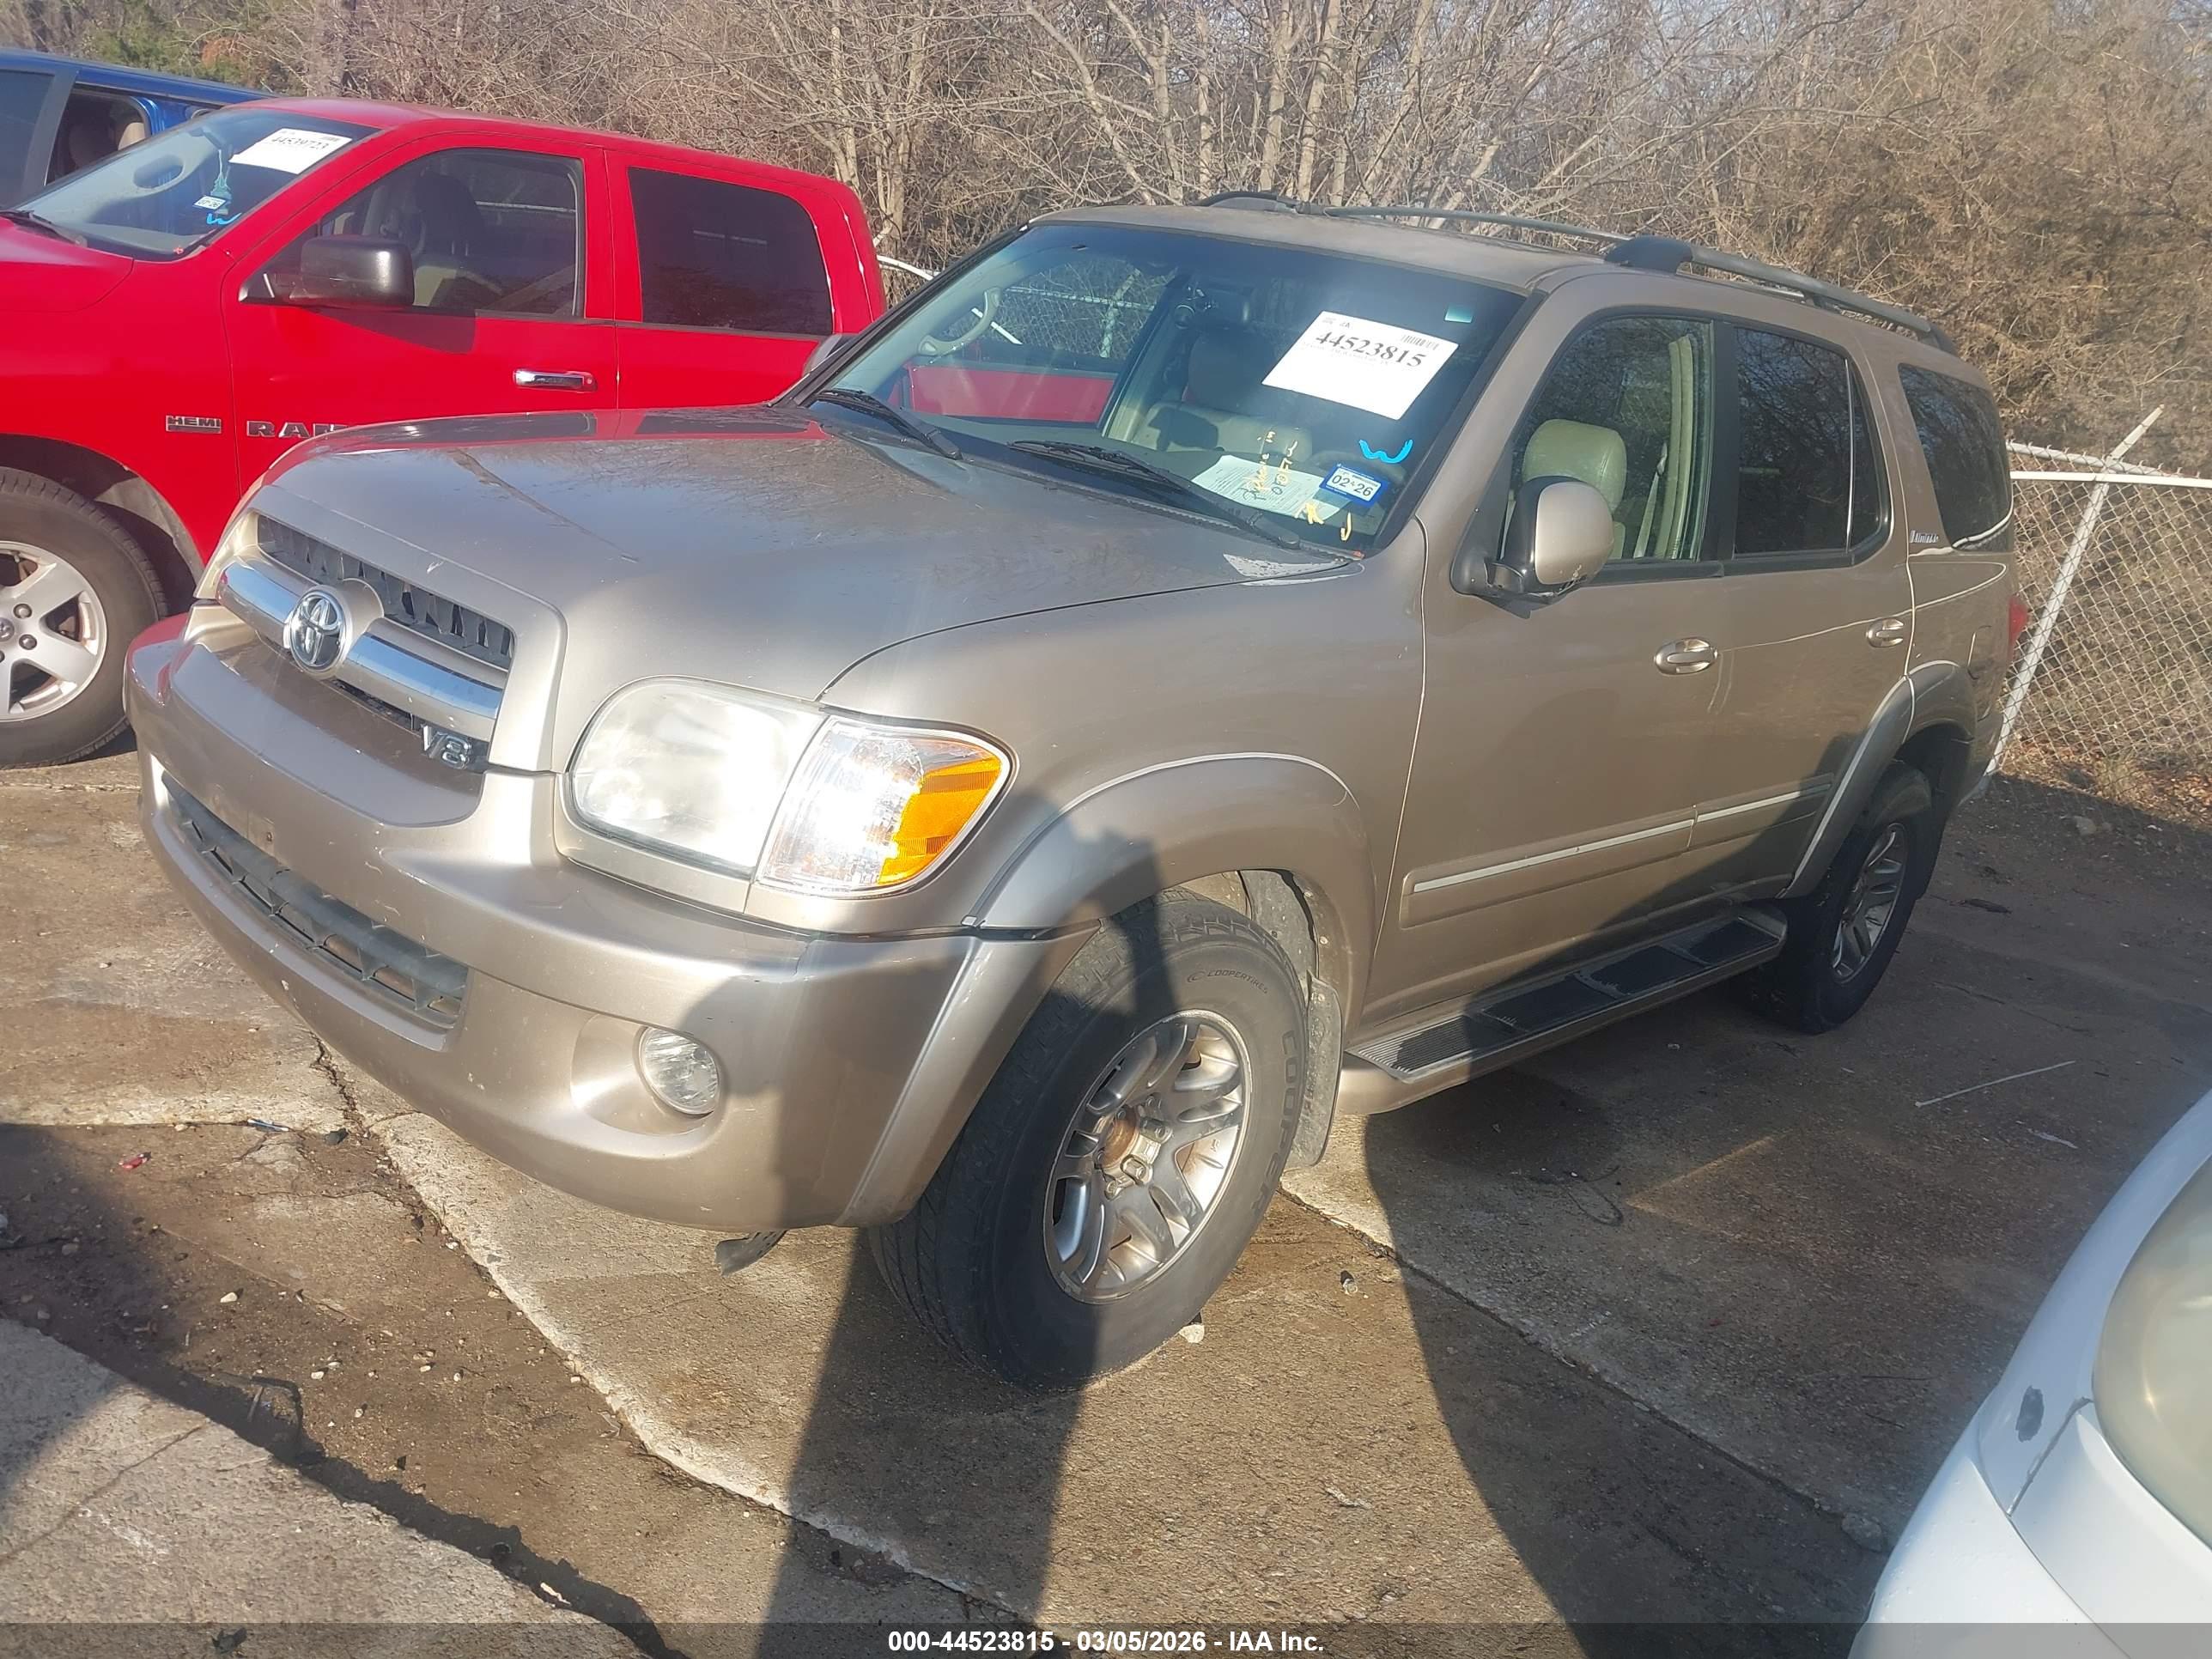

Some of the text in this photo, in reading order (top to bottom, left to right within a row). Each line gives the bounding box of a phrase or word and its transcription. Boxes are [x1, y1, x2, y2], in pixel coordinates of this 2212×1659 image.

[1316, 331, 1426, 367] 44523815
[167, 416, 221, 428] HEMI
[422, 725, 470, 769] V8
